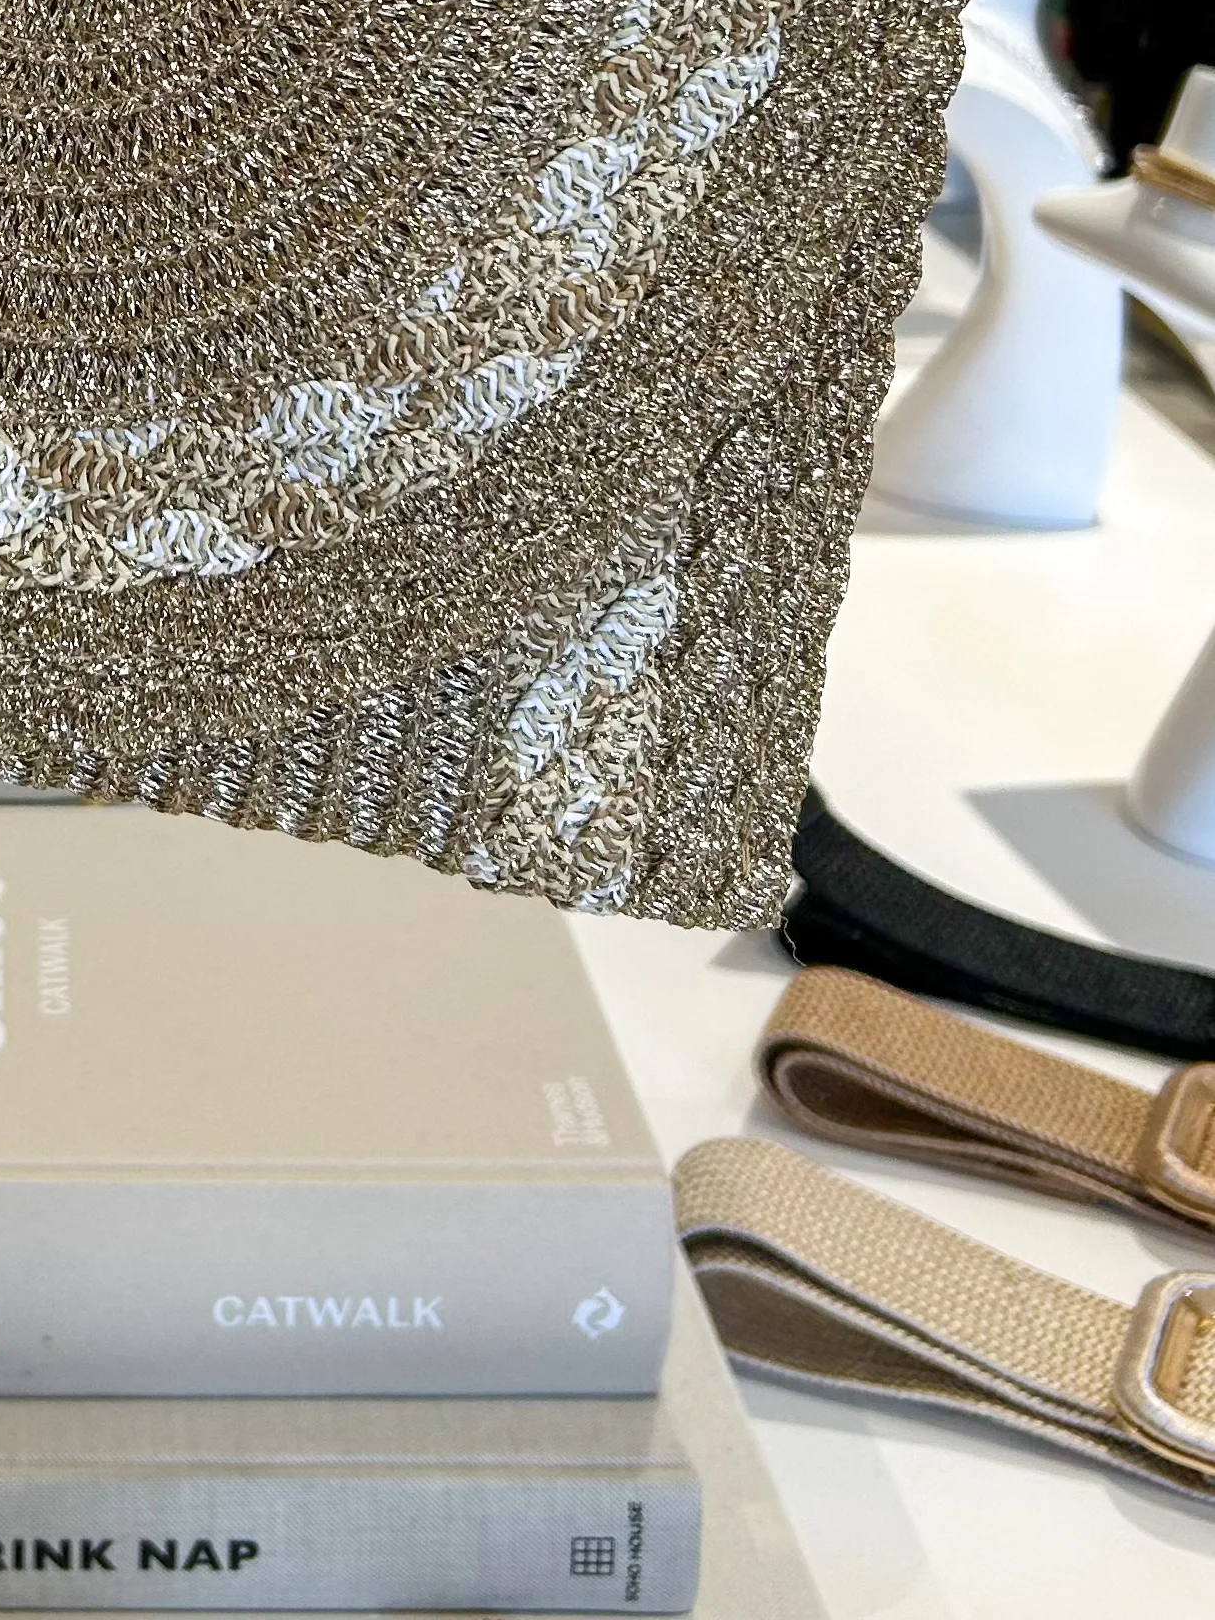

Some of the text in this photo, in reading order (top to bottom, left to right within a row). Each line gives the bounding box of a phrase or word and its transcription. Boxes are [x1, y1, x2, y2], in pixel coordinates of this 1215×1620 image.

[37, 918, 72, 1014] CATWALK
[212, 1295, 444, 1329] CATWALK
[627, 1501, 644, 1560] HOUSE
[138, 1538, 260, 1572] NAP
